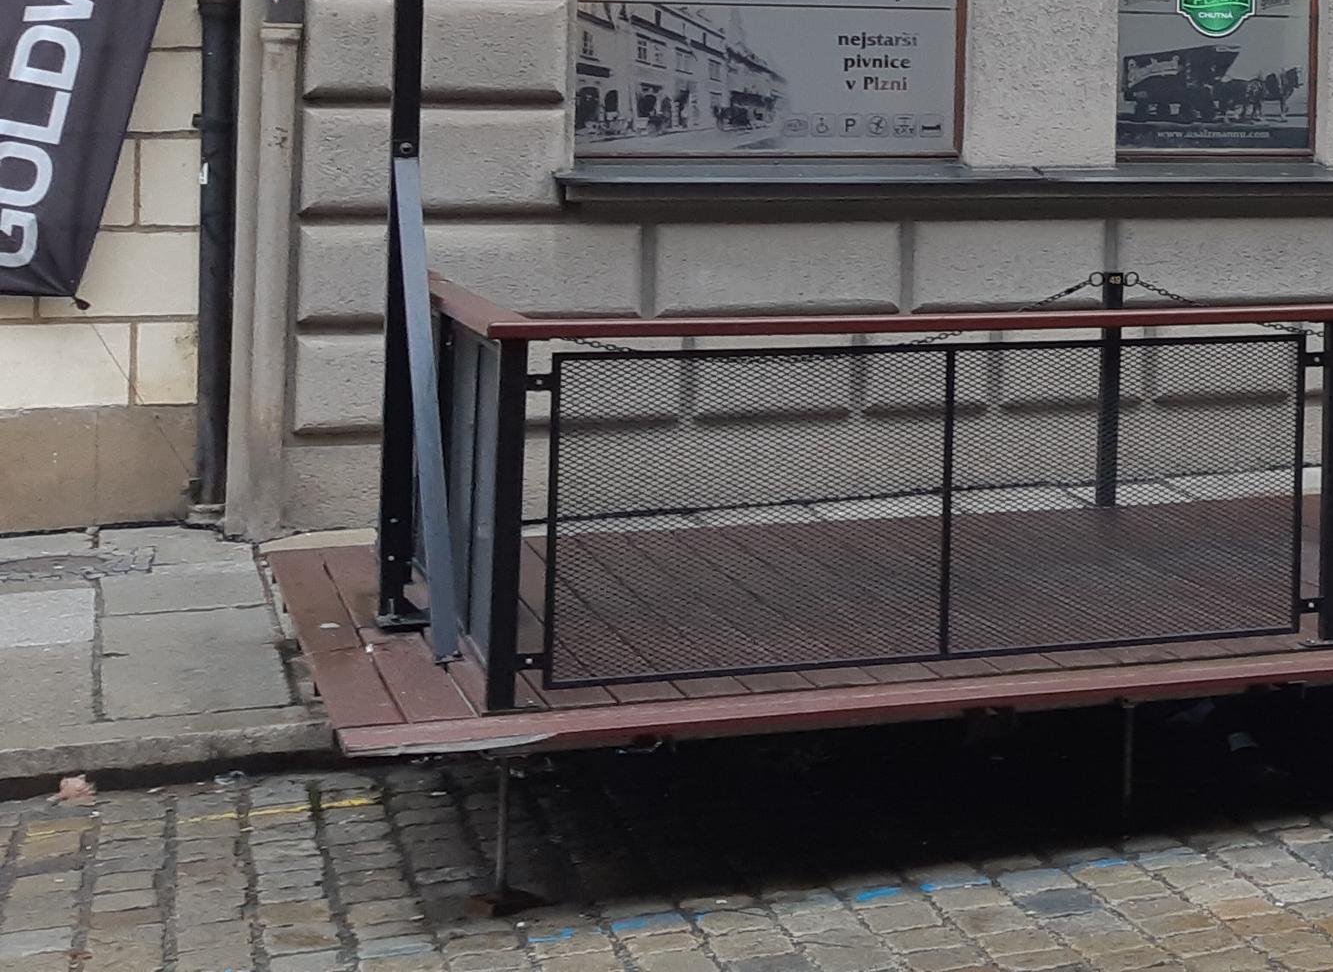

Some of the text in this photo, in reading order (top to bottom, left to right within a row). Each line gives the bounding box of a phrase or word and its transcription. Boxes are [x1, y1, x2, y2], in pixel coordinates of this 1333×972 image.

[1197, 11, 1234, 19] CHUTNÁ
[837, 31, 919, 49] nejstarší
[843, 54, 912, 72] pivnice
[845, 76, 908, 91] v Plzni
